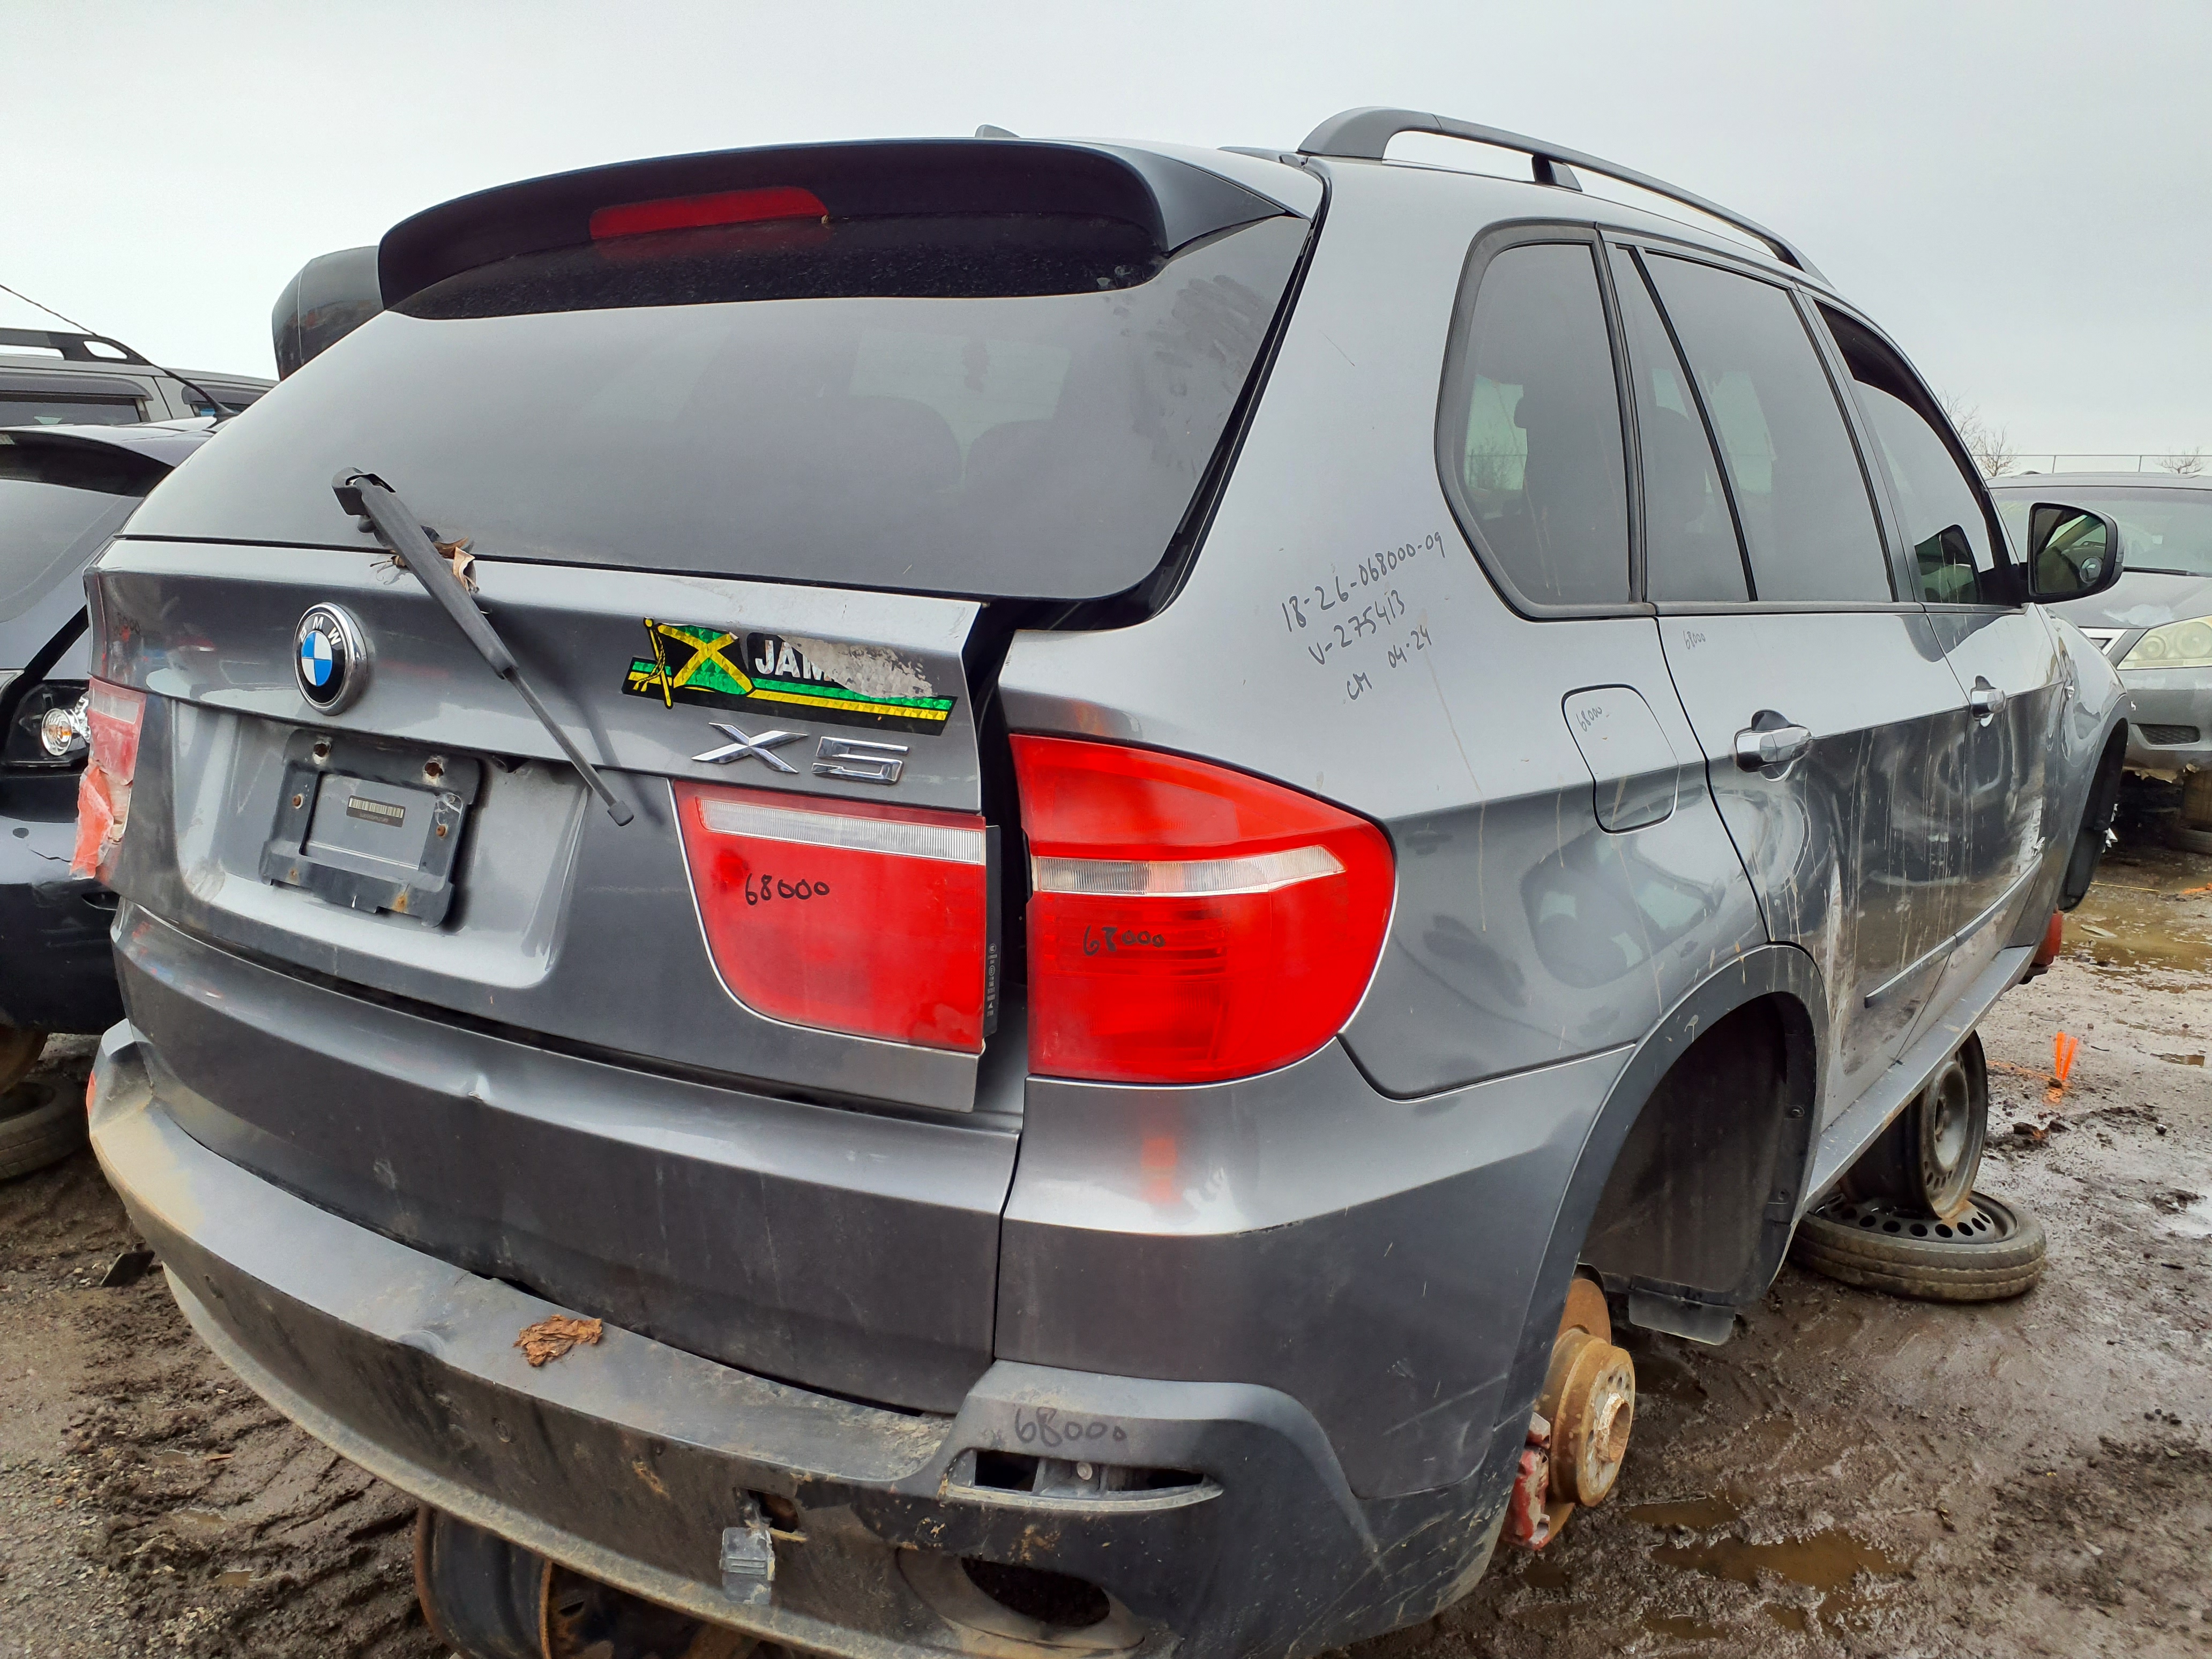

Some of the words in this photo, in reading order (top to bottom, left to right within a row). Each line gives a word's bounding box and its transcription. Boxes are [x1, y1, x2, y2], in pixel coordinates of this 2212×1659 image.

[1282, 532, 1445, 632] 18-26-068000-09
[299, 616, 342, 646] BMW
[1683, 630, 1706, 649] 68000
[1576, 707, 1602, 732] 68000
[745, 873, 830, 906] 68000
[1015, 1407, 1127, 1447] 68000
